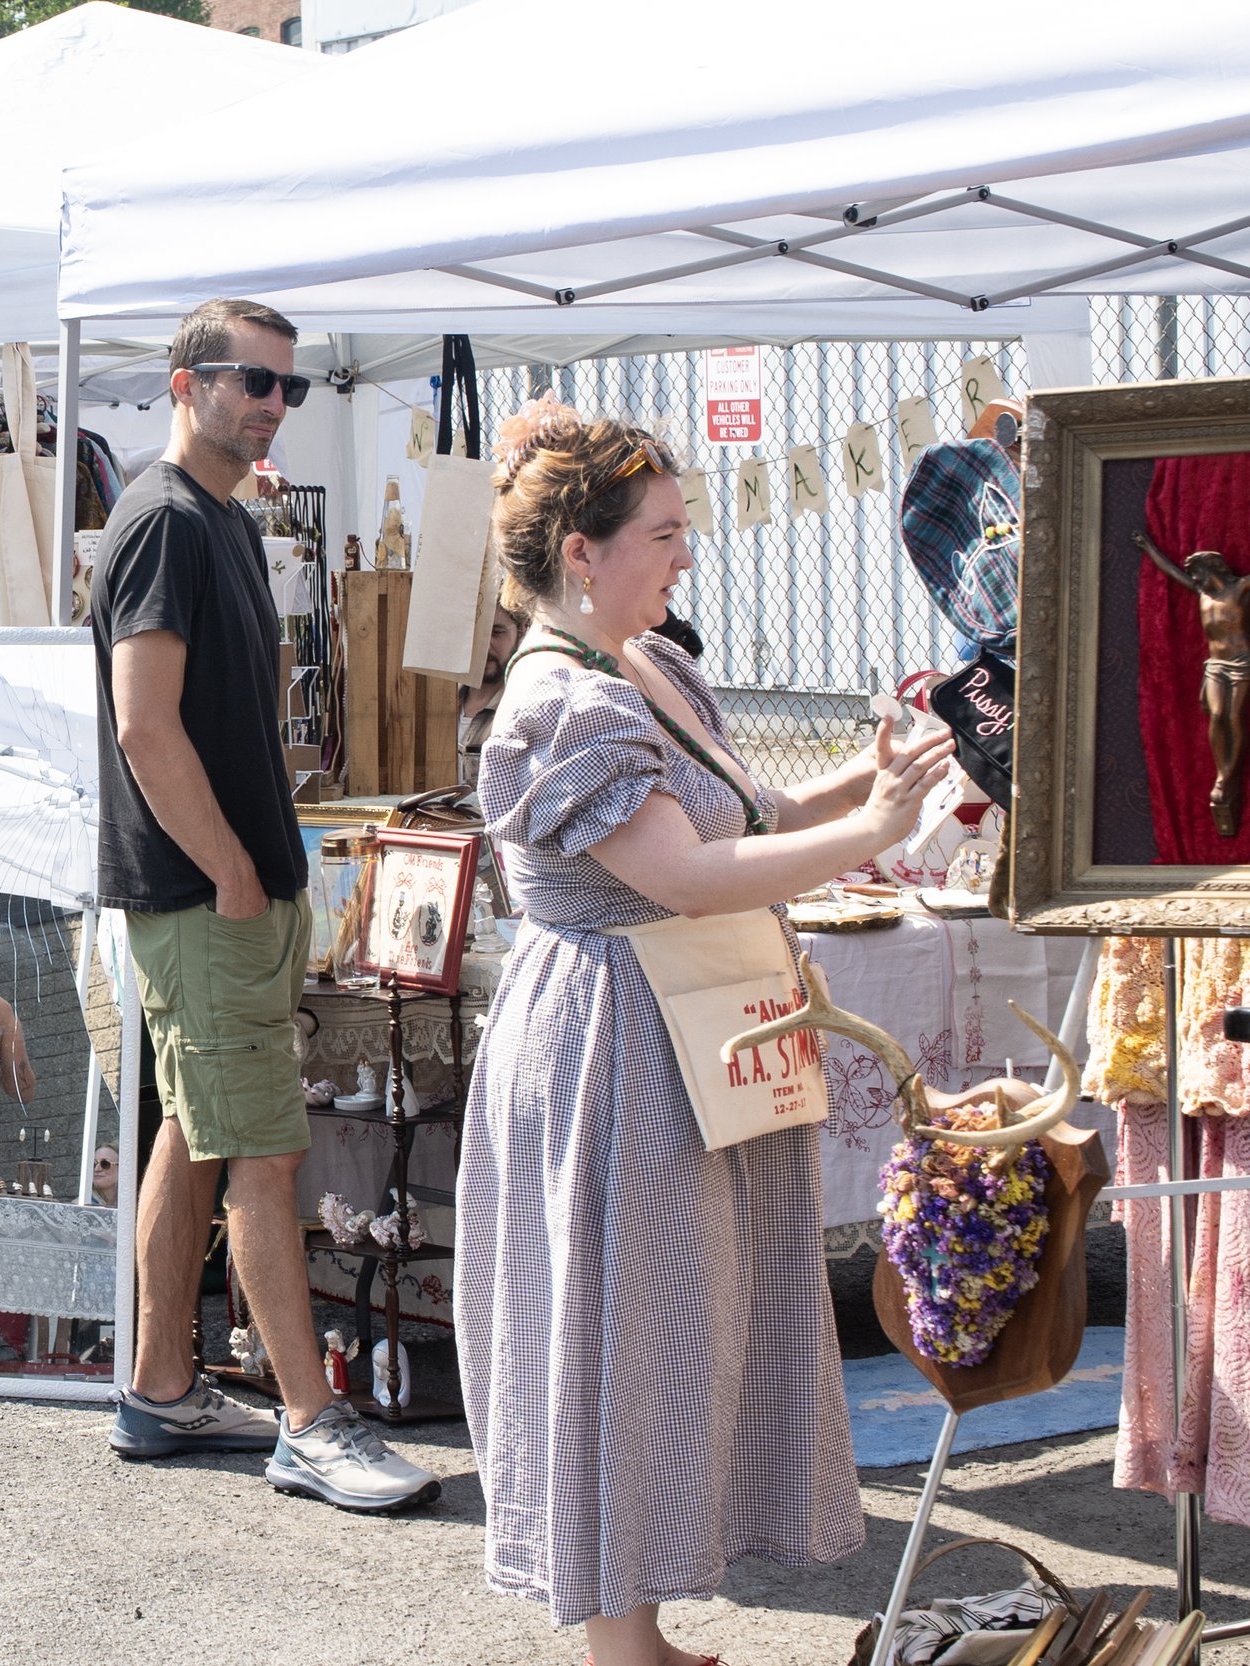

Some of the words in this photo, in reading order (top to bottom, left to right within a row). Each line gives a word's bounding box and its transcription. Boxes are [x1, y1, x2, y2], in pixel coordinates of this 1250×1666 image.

[716, 359, 751, 374] CUSTOMER
[710, 380, 738, 393] PARKING
[740, 379, 758, 393] ONLY
[717, 402, 729, 413] ALL
[730, 401, 750, 413] OTHER
[712, 414, 740, 426] VEHICLES
[741, 414, 756, 425] WILL
[719, 428, 728, 439] BE
[729, 427, 749, 439] TOWED
[965, 1048, 982, 1064] Eat
[773, 1085, 794, 1099] ITEM
